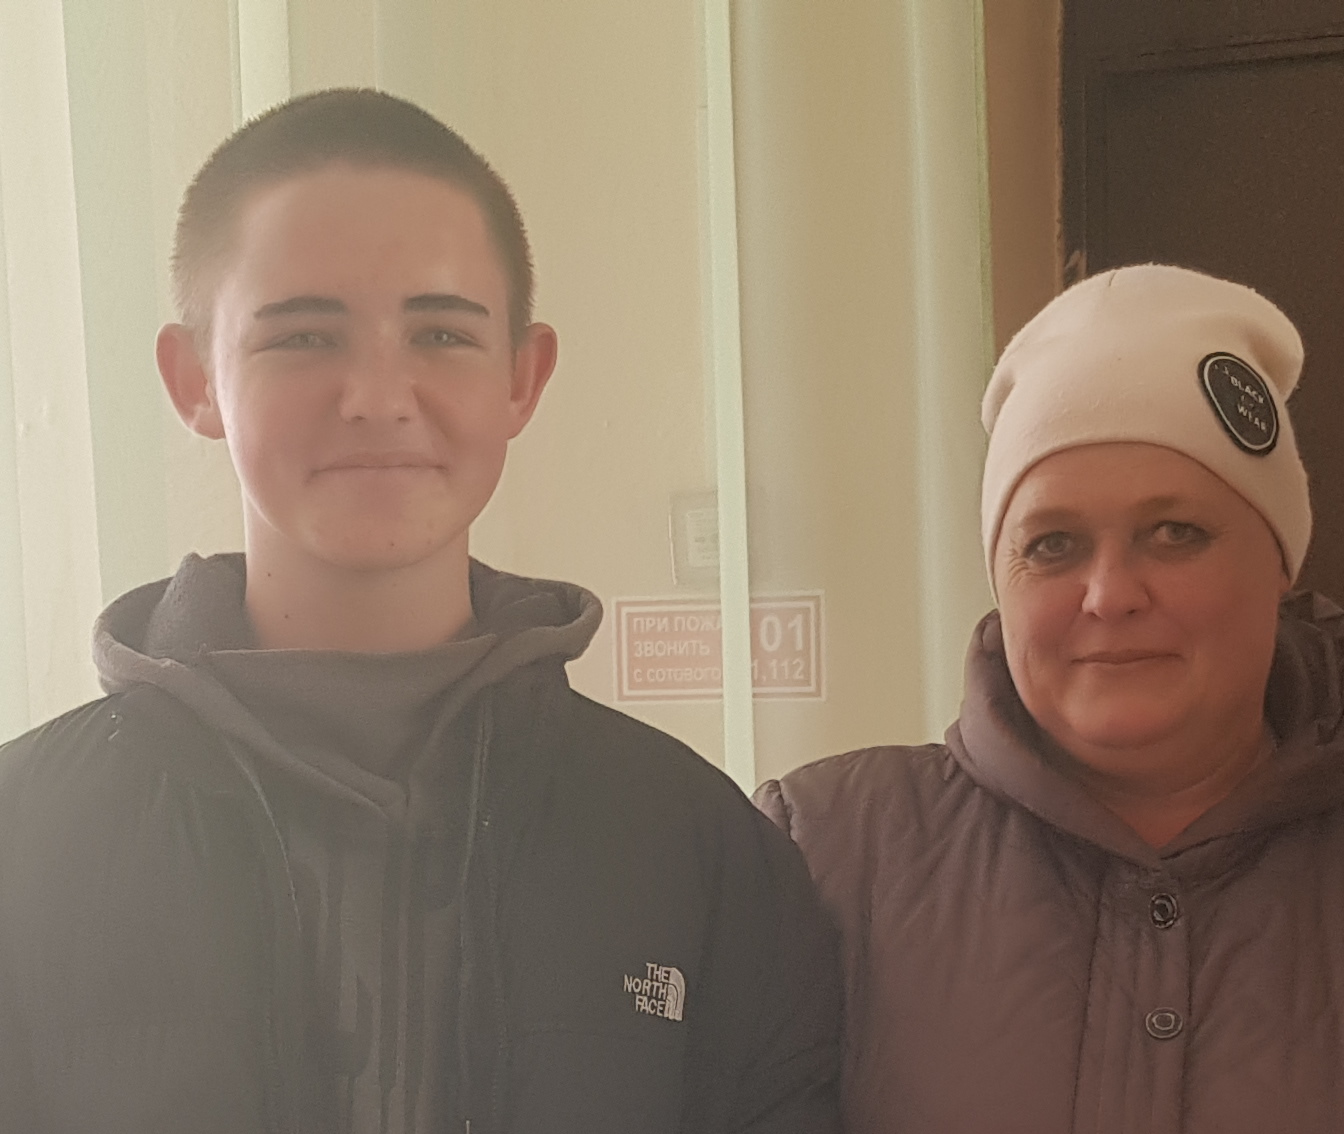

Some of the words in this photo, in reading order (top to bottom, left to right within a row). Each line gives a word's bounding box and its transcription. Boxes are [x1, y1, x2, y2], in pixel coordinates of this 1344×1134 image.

[633, 616, 669, 633] ПРИ
[674, 615, 722, 633] ПОЖ
[760, 613, 805, 652] 01
[633, 640, 710, 658] ЗВОНИТЬ
[646, 962, 671, 983] THE
[624, 974, 668, 1000] NORTH
[636, 994, 666, 1017] FACE
